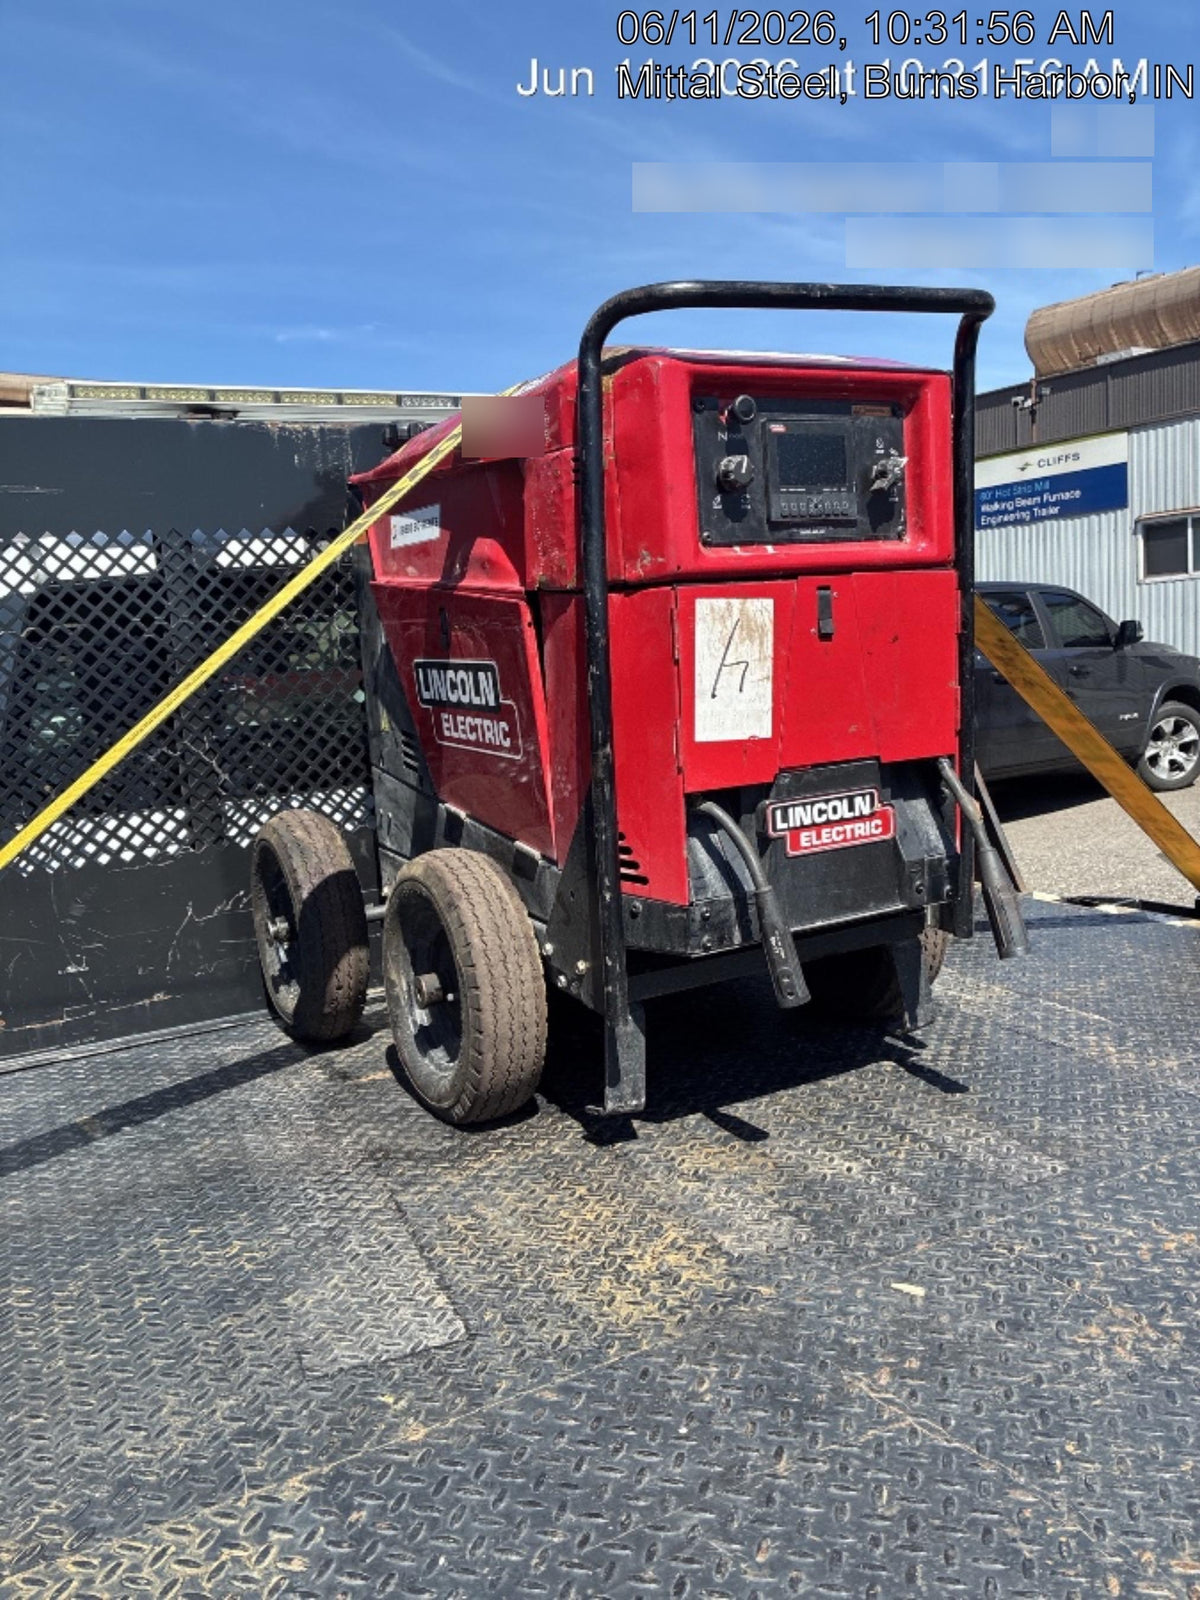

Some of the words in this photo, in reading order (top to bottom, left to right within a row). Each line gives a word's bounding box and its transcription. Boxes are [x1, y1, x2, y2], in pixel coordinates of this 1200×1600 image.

[1037, 452, 1081, 468] CLIFFS
[1043, 489, 1082, 503] Furnace
[980, 509, 1031, 527] Engineering
[418, 667, 496, 706] LINCOLN
[440, 712, 511, 748] ELECTRIC
[775, 794, 871, 830] LINCOLN
[799, 818, 883, 847] ELECTRIC
